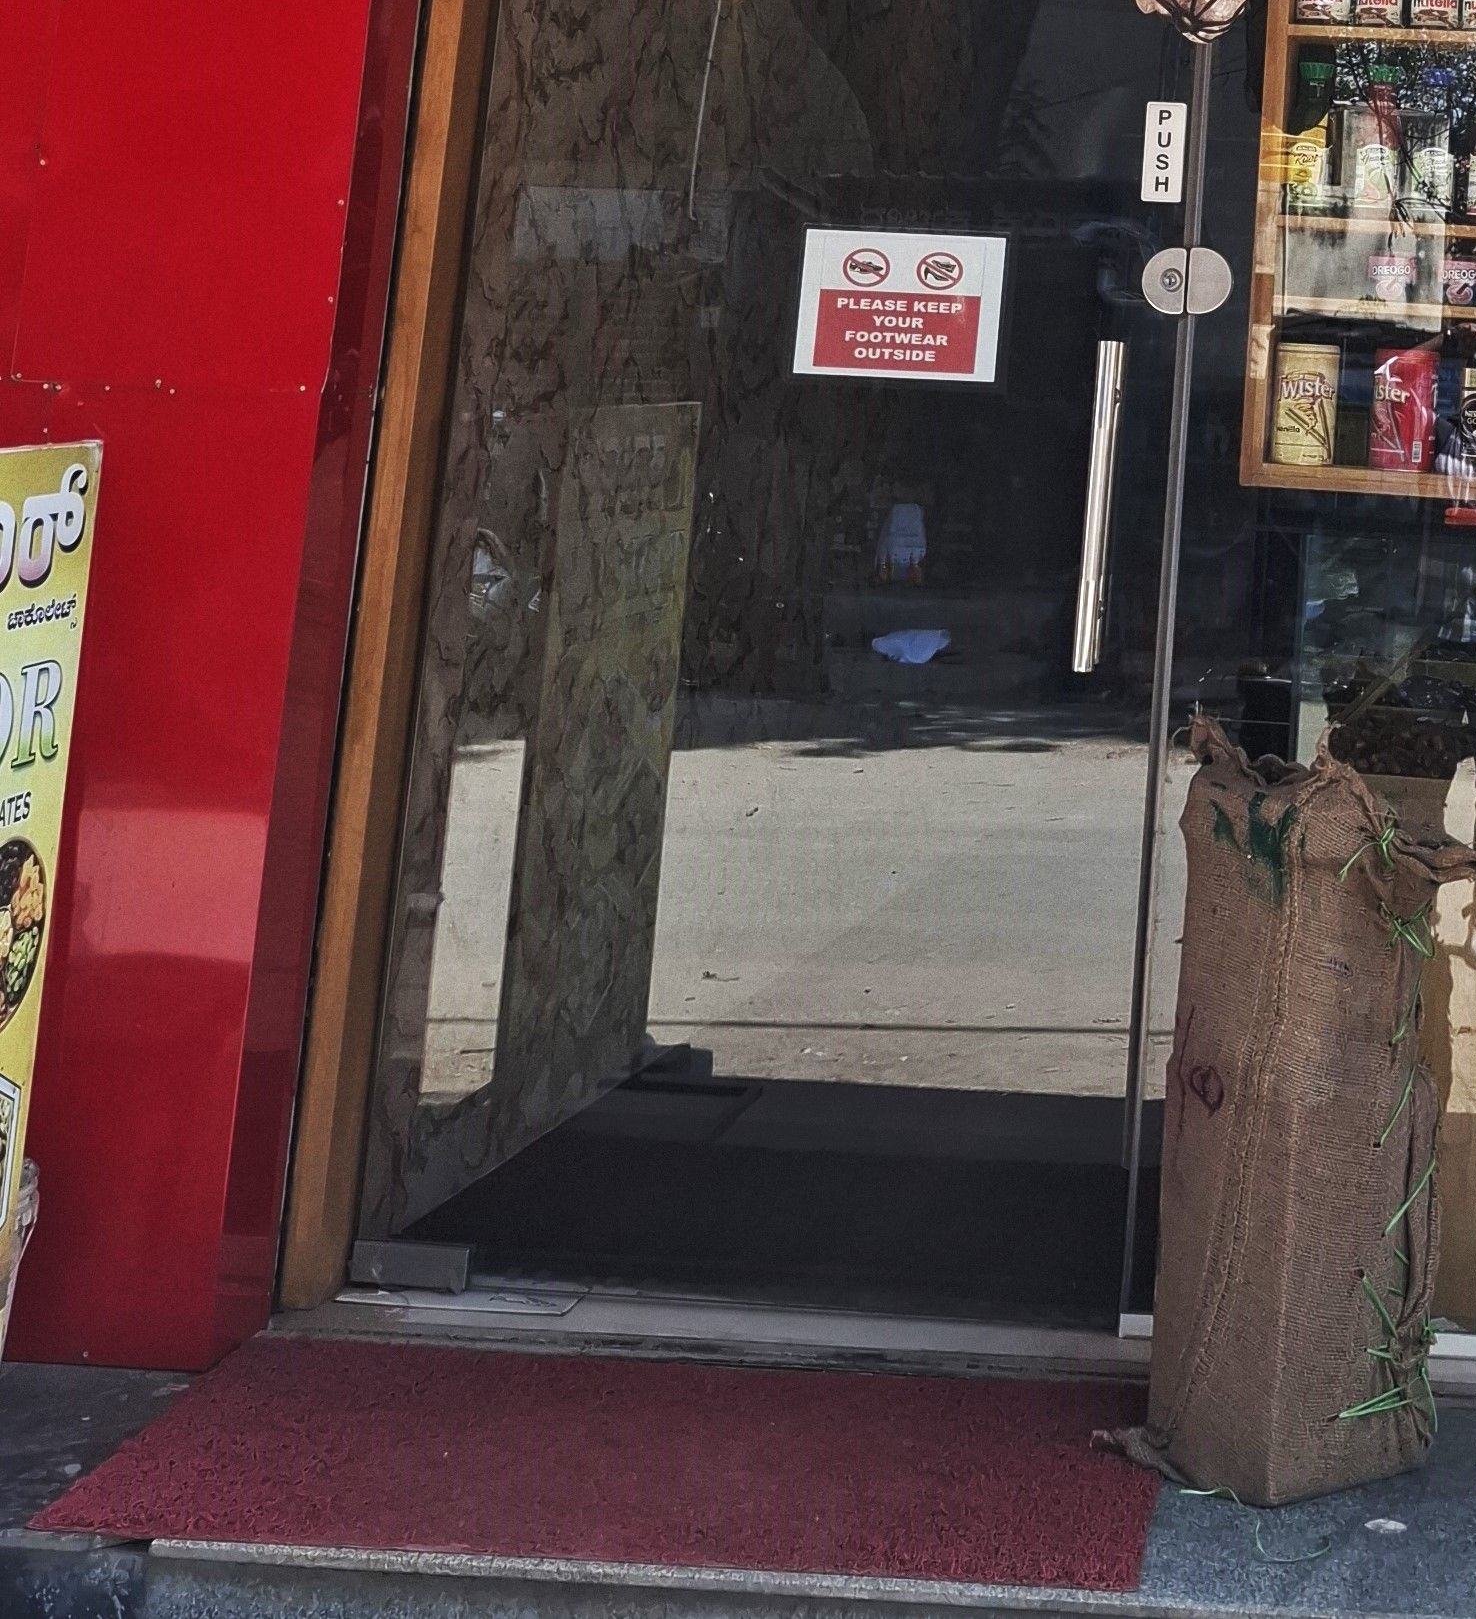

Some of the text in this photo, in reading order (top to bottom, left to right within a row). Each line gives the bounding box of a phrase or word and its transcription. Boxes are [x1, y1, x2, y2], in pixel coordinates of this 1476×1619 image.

[1154, 110, 1172, 193] PUSH
[1371, 264, 1411, 276] OREOGO
[836, 296, 963, 314] PLEASE KEEP
[872, 315, 924, 329] YOUR
[844, 330, 948, 346] FOOTWEAR
[854, 347, 936, 362] OUTSIDE
